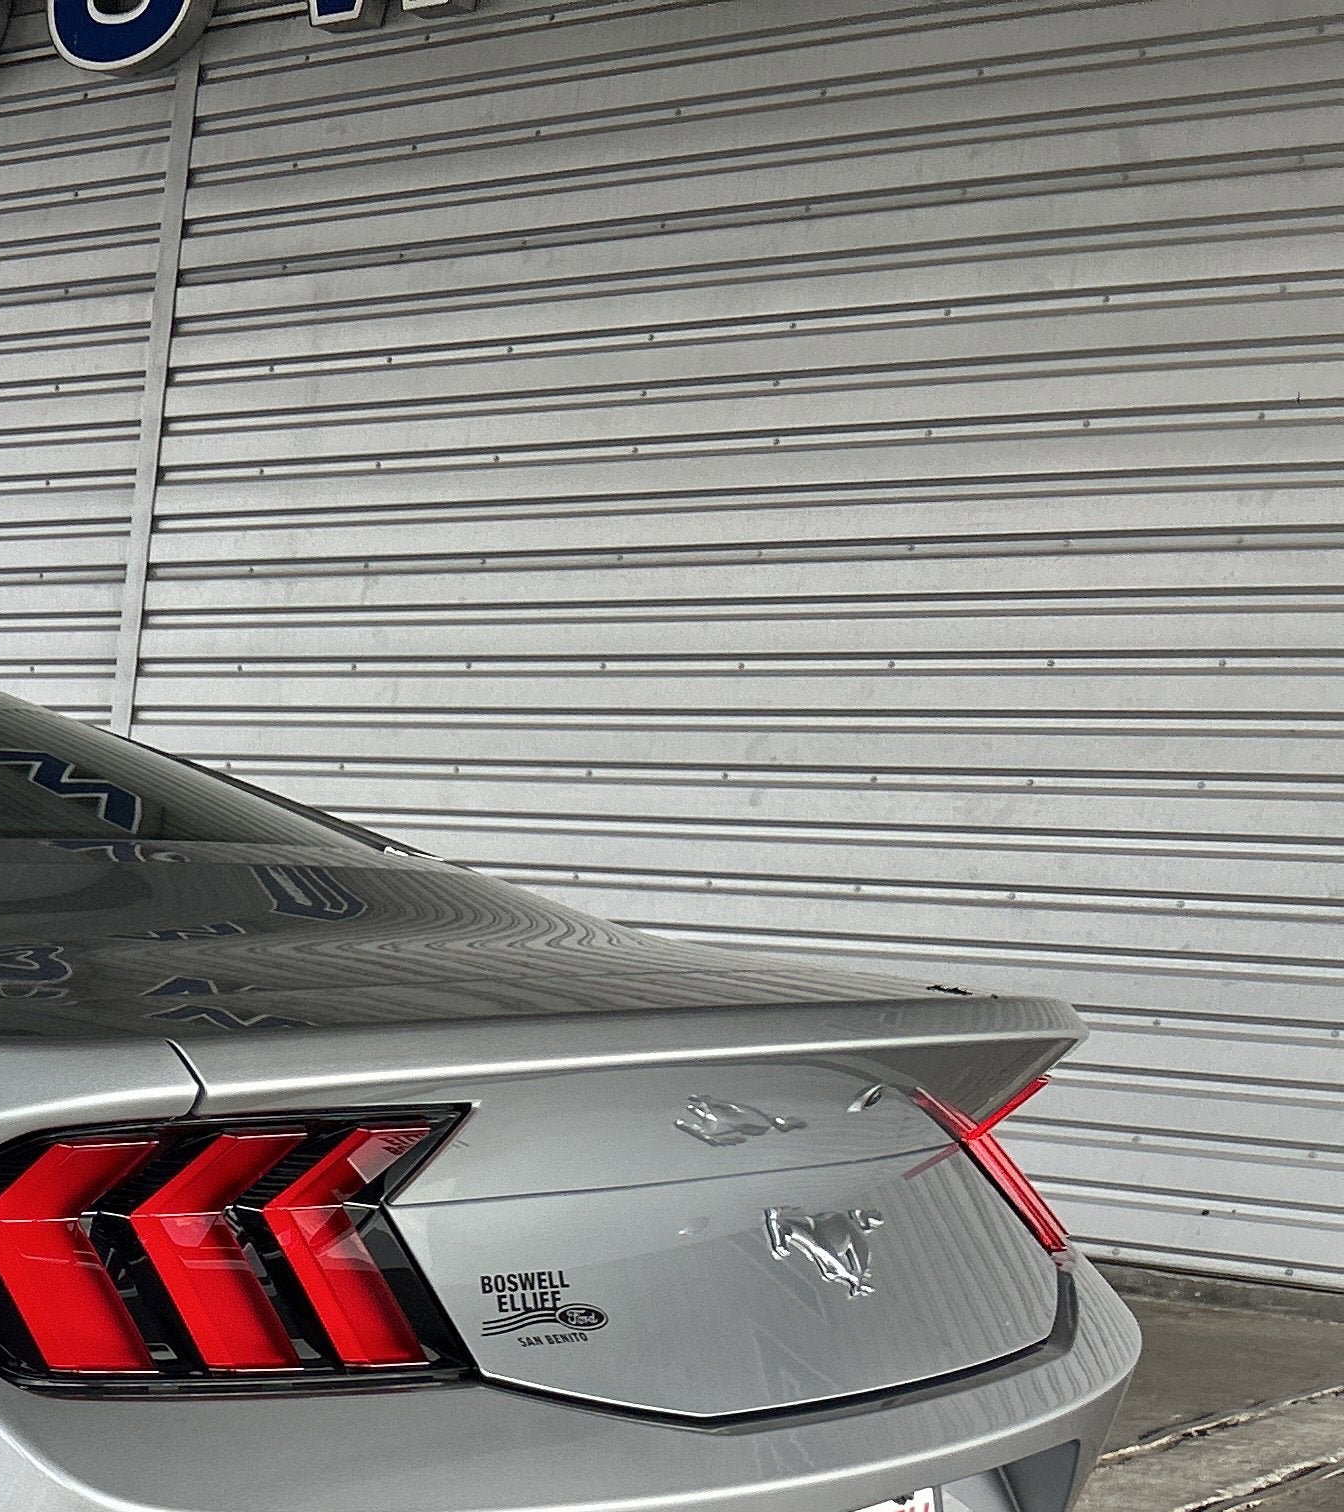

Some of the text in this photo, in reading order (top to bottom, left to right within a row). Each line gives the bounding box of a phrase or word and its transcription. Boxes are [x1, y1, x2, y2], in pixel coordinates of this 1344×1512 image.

[480, 1270, 570, 1294] BOSWELL
[497, 1290, 562, 1313] ELLIFF
[517, 1332, 588, 1348] SAN BENITO
